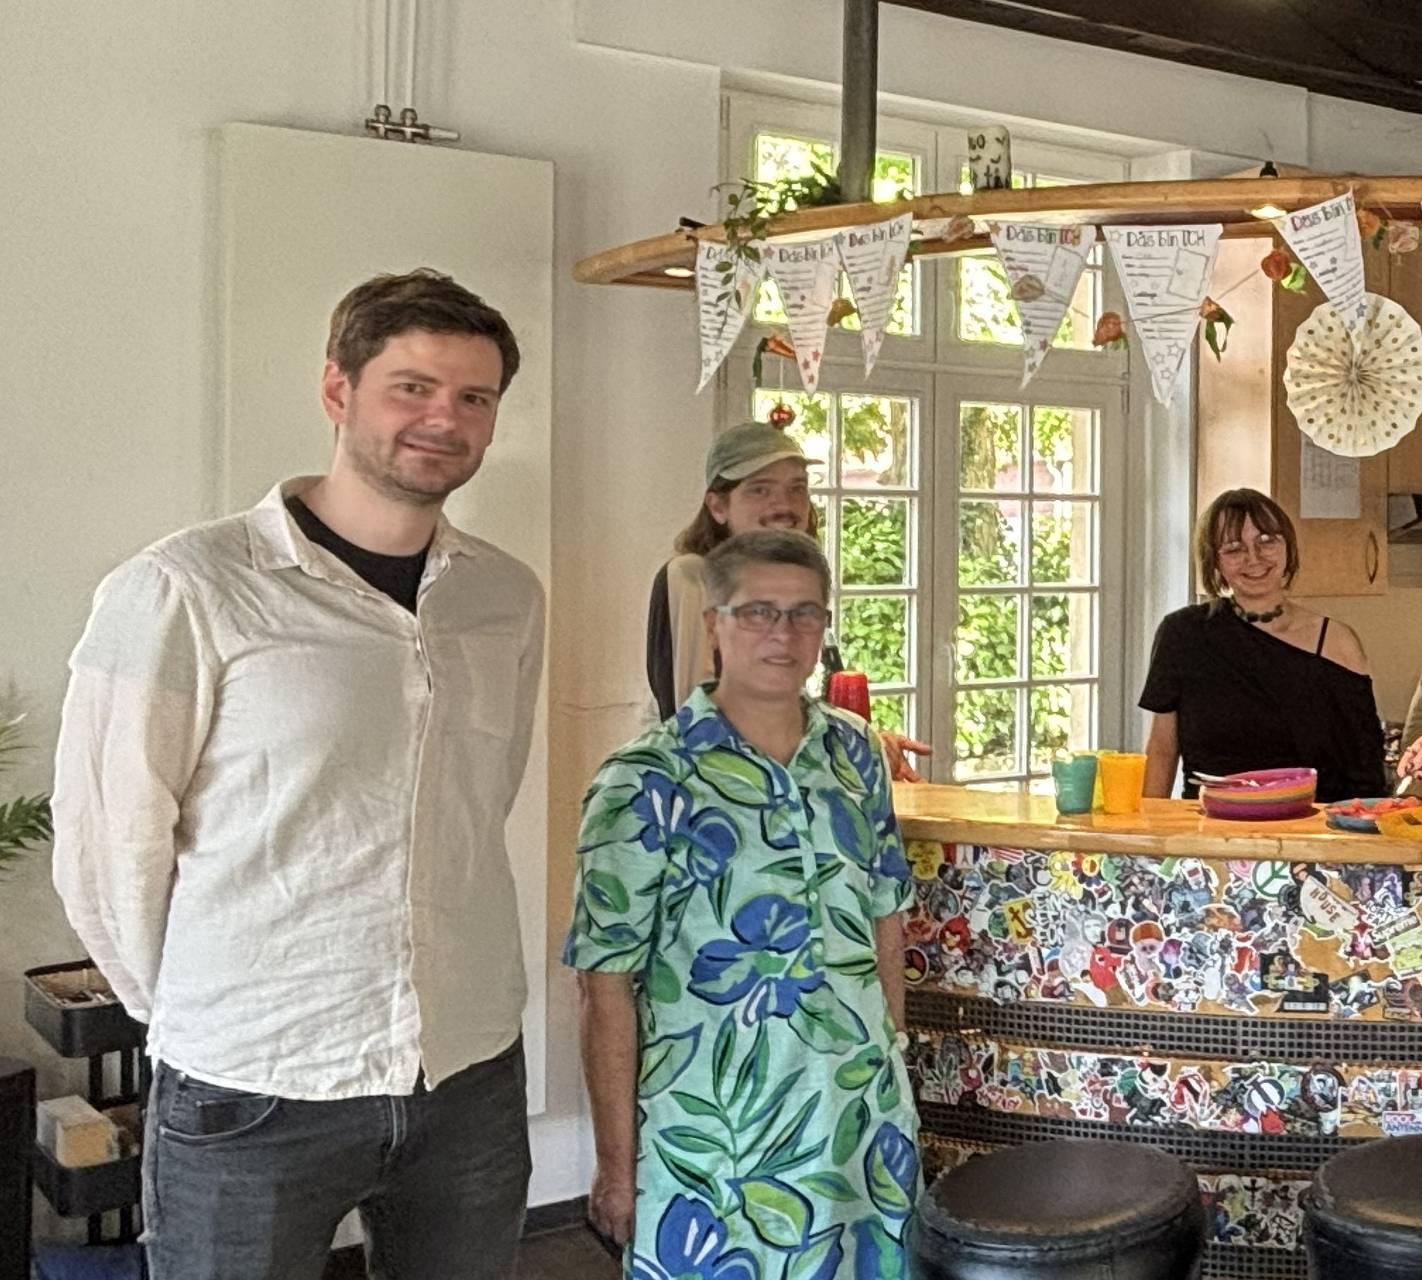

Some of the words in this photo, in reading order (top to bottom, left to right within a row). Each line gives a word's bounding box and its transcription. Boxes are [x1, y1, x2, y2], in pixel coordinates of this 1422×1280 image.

[1006, 224, 1035, 243] Das
[1126, 231, 1156, 248] Das
[1158, 231, 1180, 248] bin
[1309, 887, 1341, 923] HOUSE
